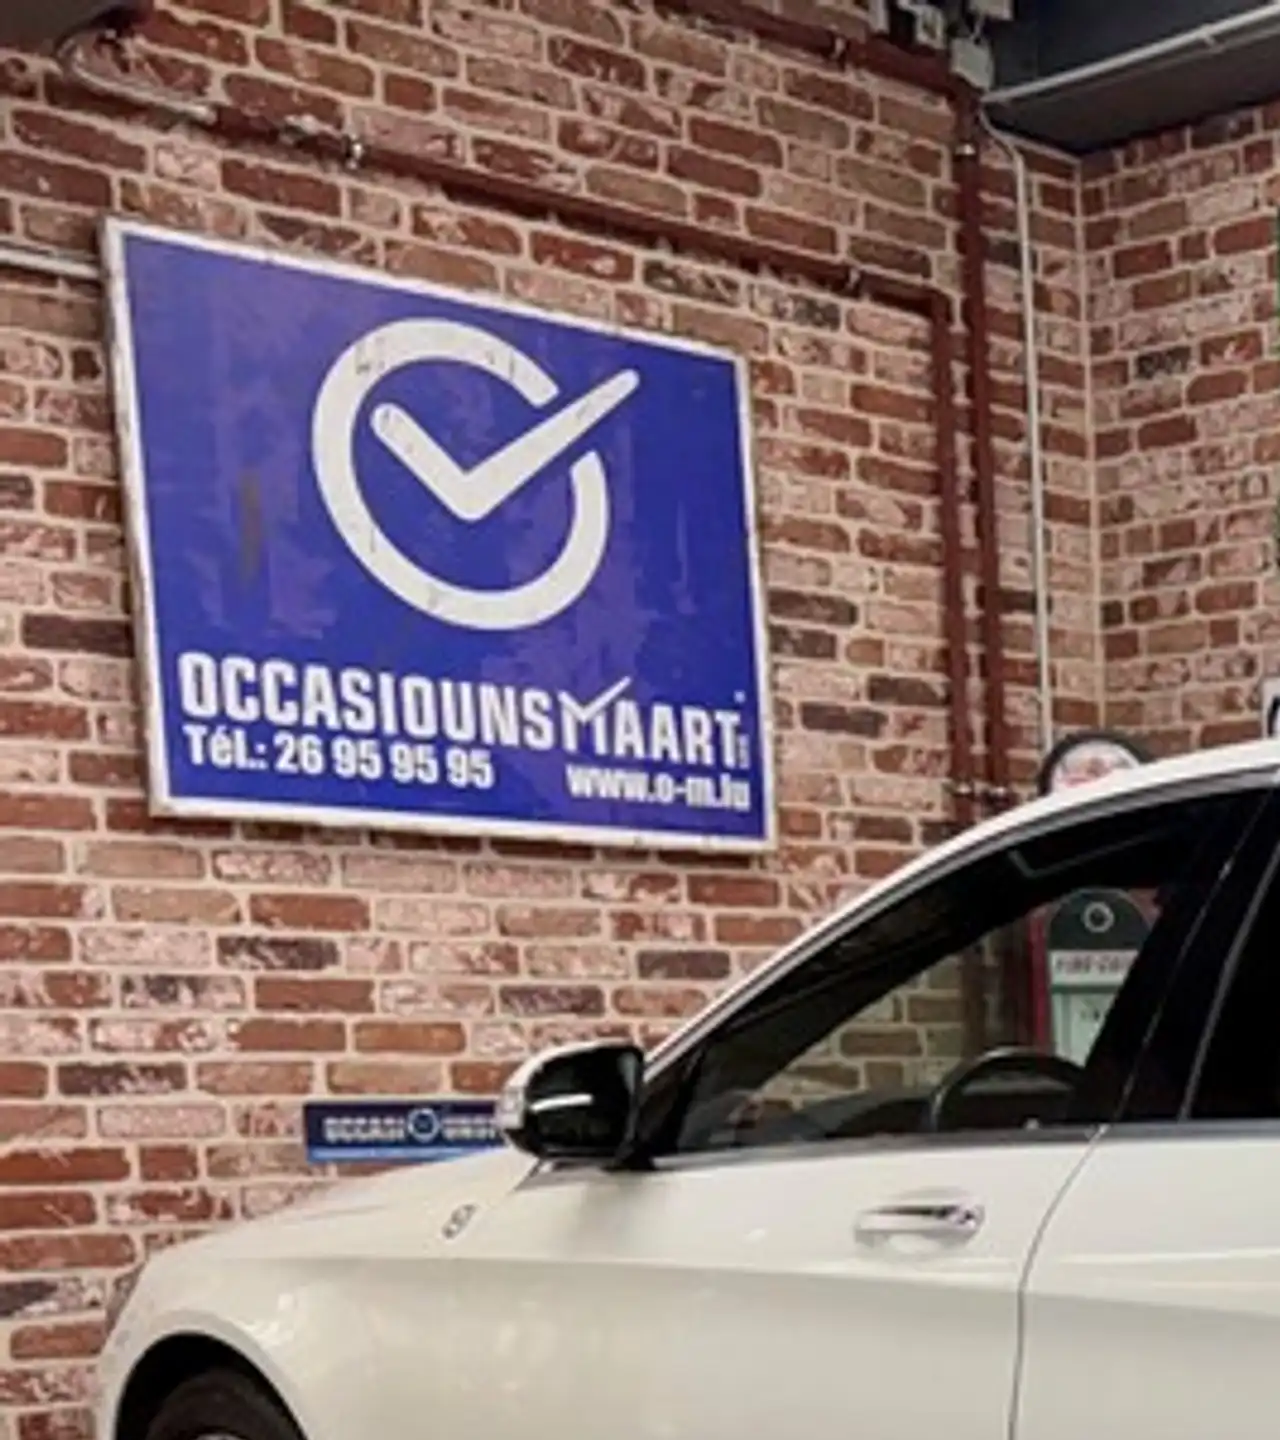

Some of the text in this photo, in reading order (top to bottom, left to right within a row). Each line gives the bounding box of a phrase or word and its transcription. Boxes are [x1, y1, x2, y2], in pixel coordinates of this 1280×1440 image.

[182, 723, 496, 791] Tél.: 26 95 95 95
[566, 763, 751, 811] www.o-m.lu
